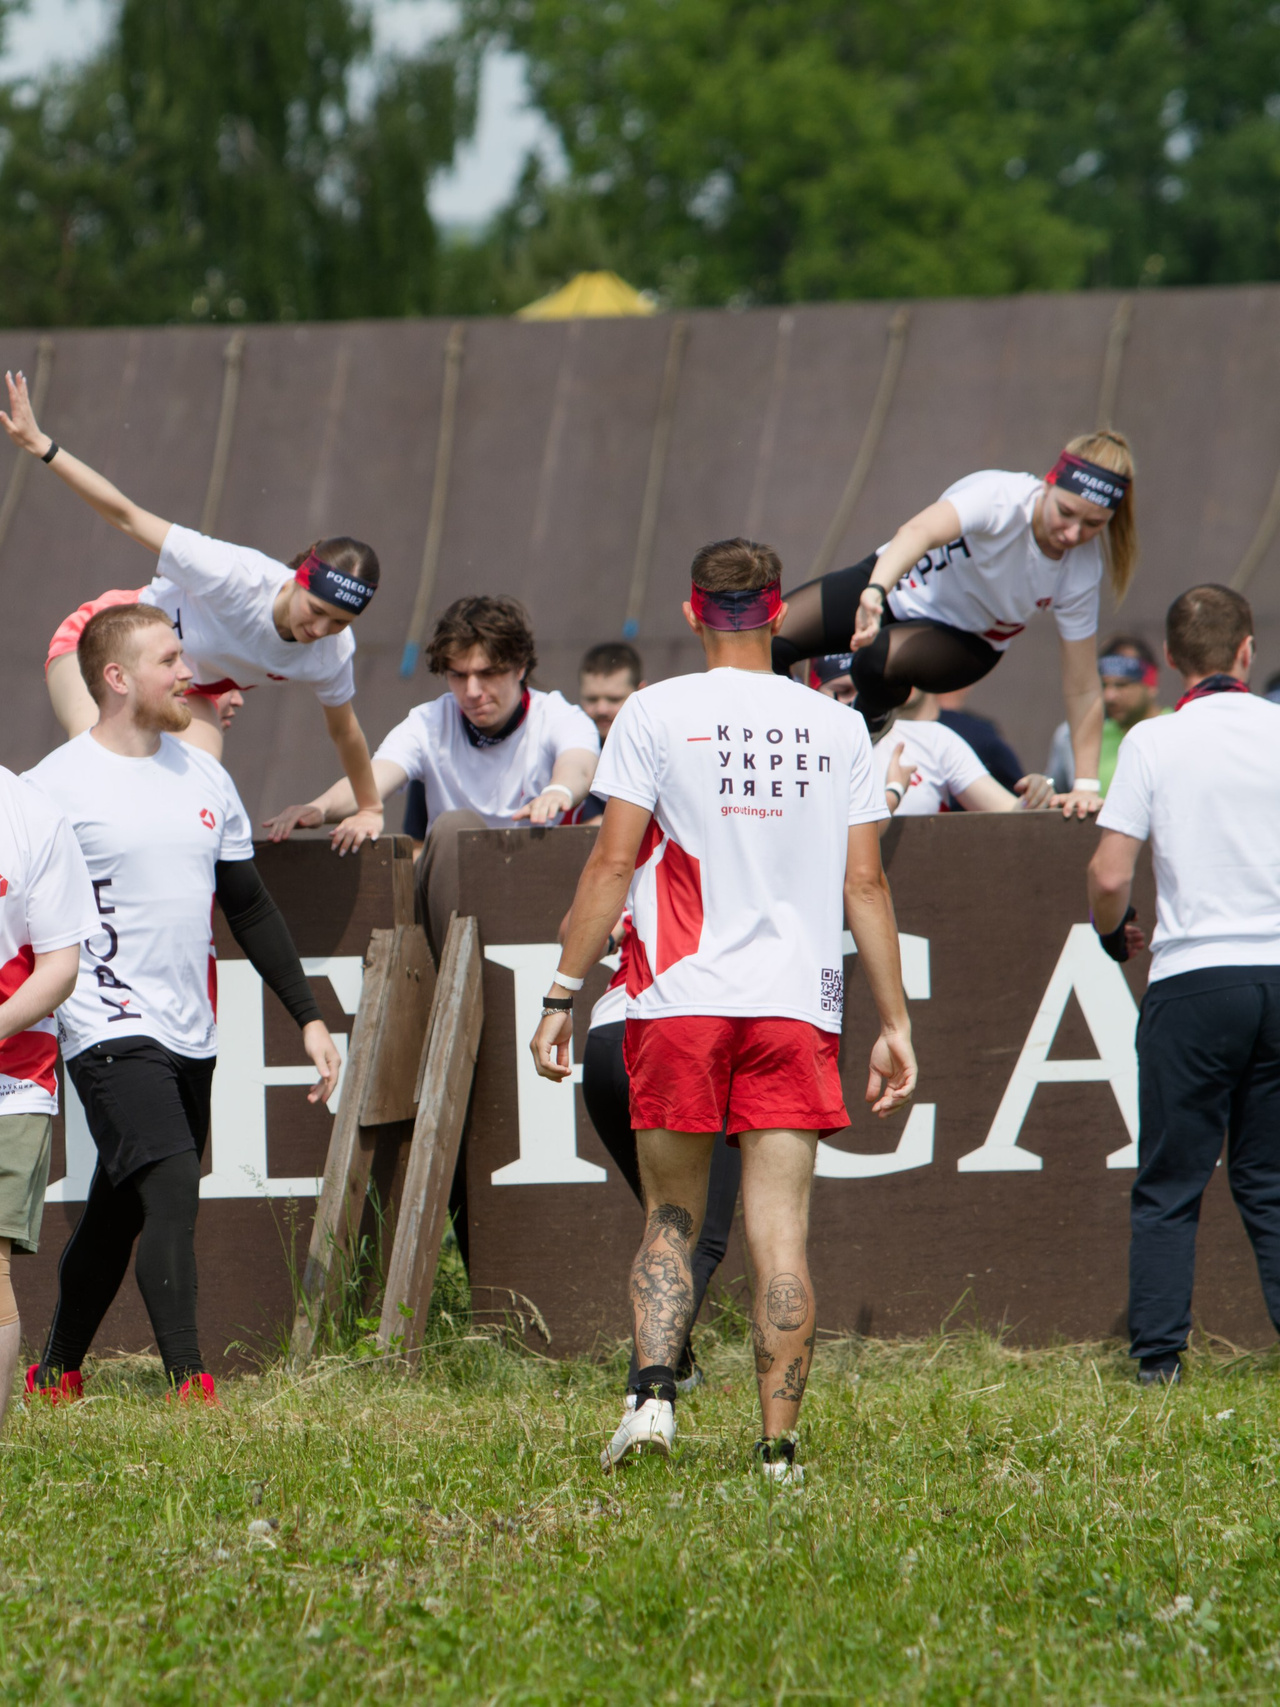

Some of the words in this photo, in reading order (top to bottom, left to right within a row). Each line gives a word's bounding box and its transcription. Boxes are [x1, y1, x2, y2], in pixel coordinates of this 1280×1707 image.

[1071, 470, 1114, 494] РОДЕО
[326, 570, 366, 594] РОДЕО
[334, 588, 363, 607] 2882
[718, 751, 831, 773] УКРЕП
[719, 778, 810, 798] ЛЯЕТ
